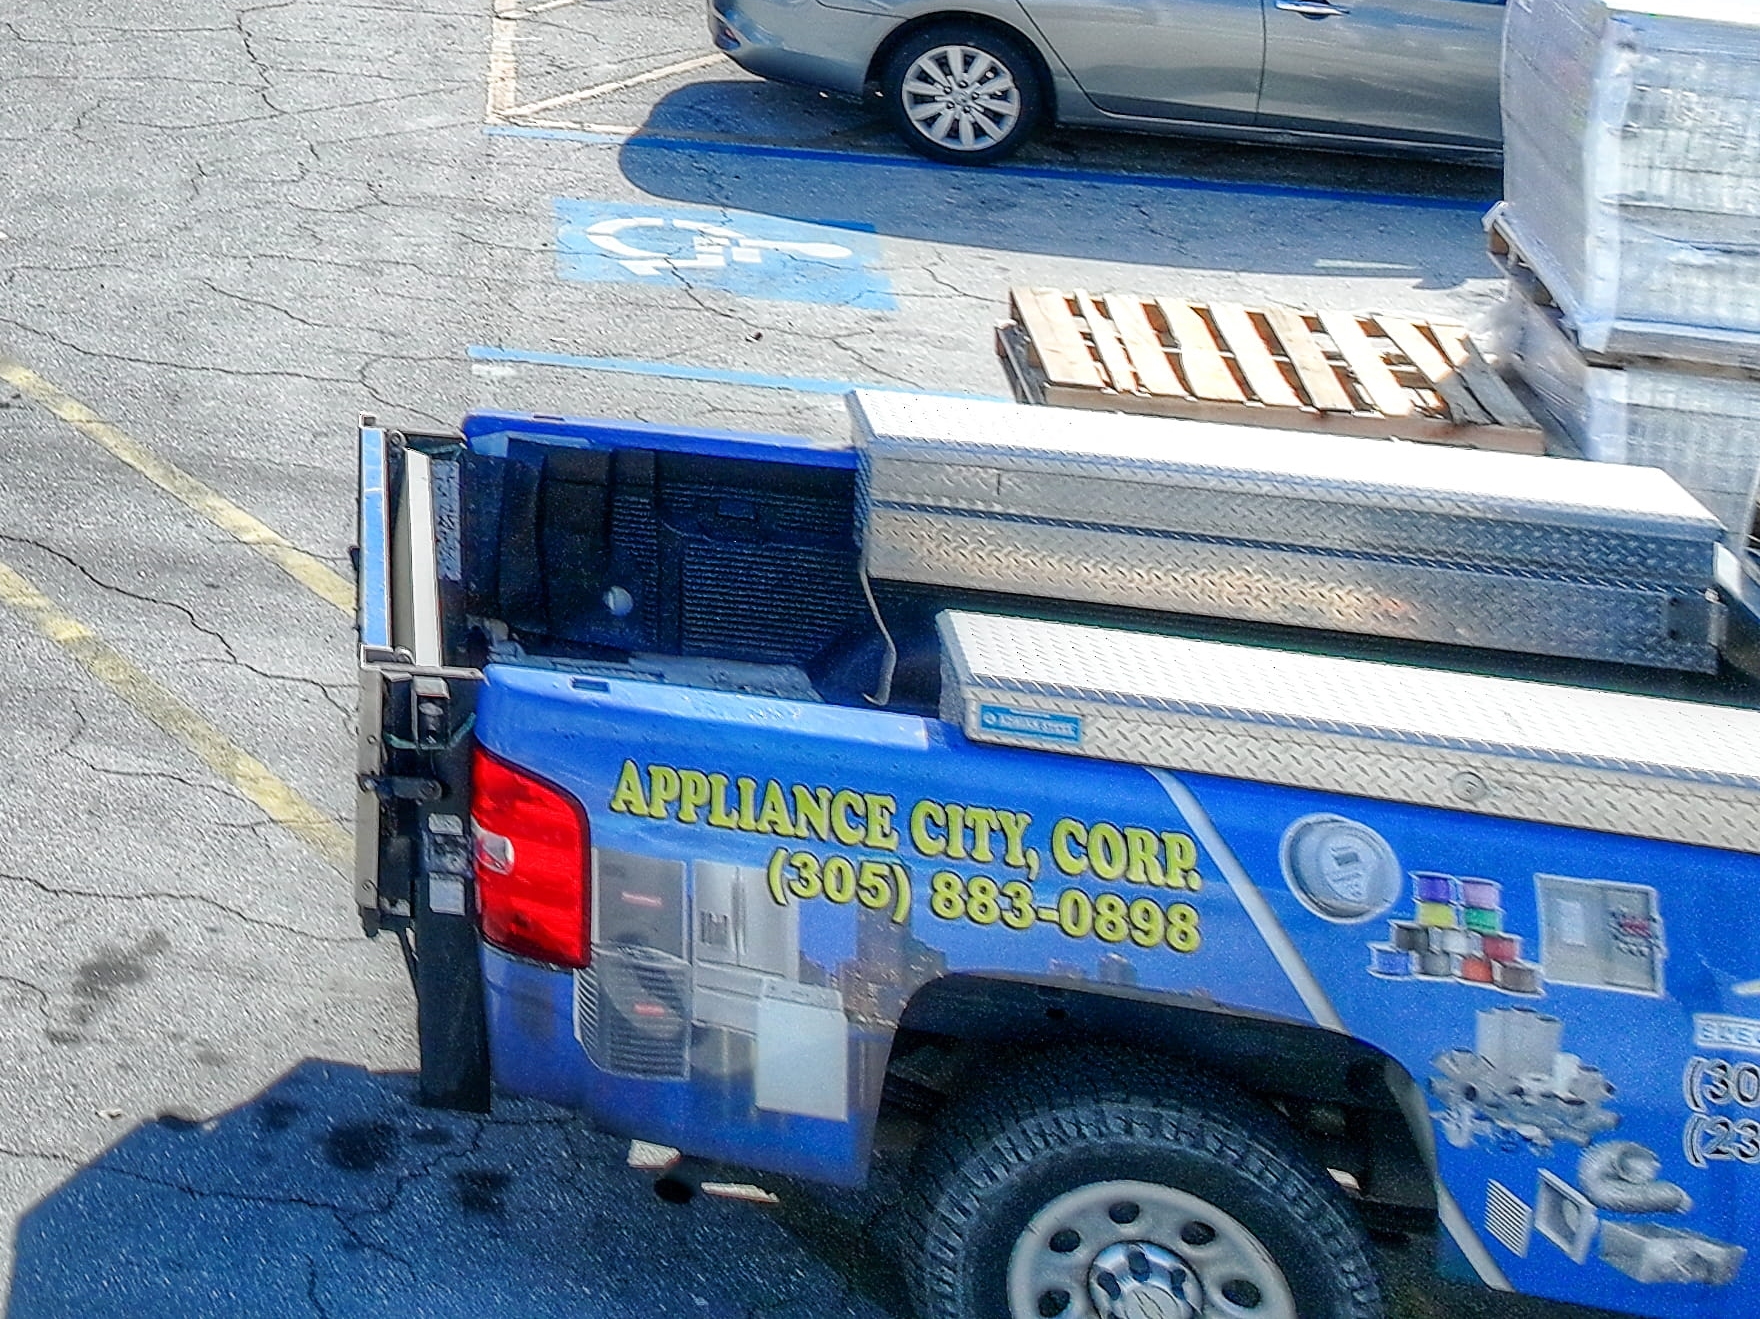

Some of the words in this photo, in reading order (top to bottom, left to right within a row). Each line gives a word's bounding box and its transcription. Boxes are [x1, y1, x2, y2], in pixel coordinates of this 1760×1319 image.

[610, 758, 898, 852] APPLIANCE
[910, 799, 1041, 879] CITY,
[1052, 818, 1203, 891] CORP.
[766, 847, 912, 924] (305)
[930, 869, 1201, 953] 883-0898
